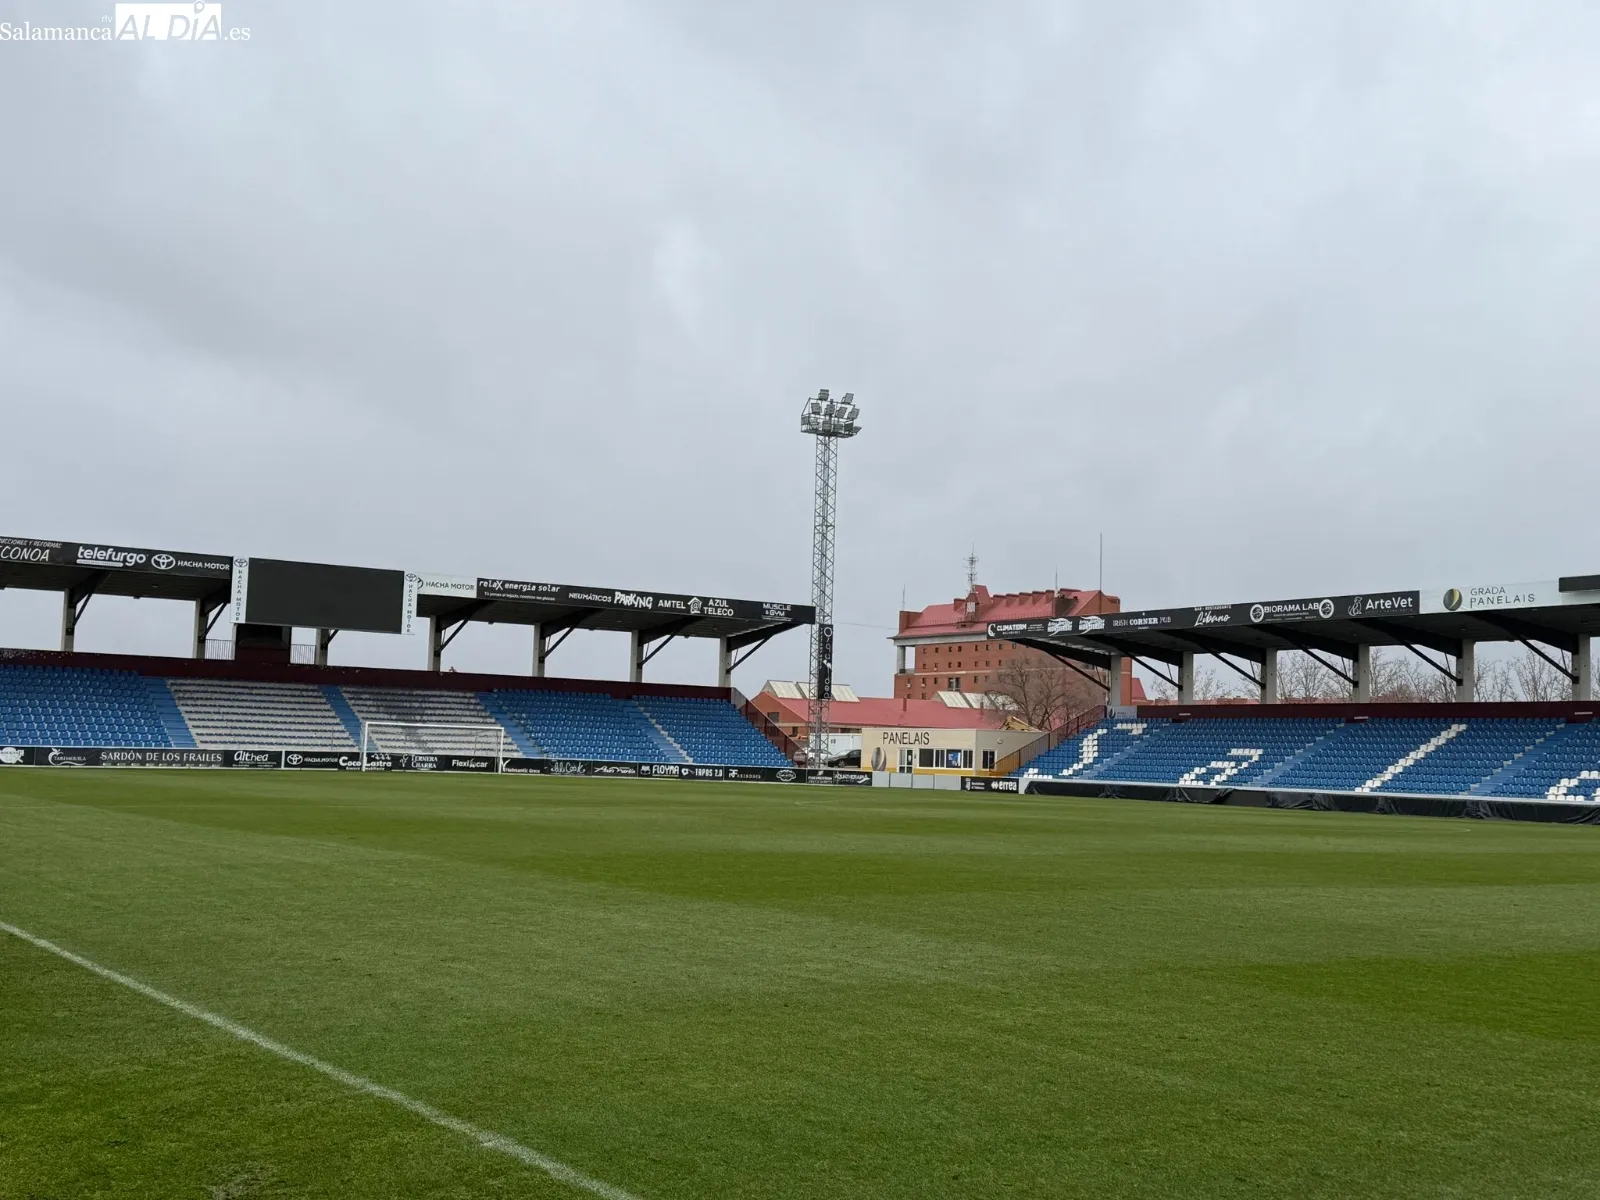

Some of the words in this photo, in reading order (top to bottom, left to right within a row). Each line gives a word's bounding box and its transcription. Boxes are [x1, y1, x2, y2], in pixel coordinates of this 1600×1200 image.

[0, 545, 50, 562] CONOA
[77, 546, 147, 567] telefurgo
[177, 560, 203, 568] HACHA
[204, 562, 230, 571] MOTOR
[425, 581, 449, 589] HACHA
[450, 583, 475, 591] MOTOR
[1470, 586, 1506, 596] GRADA
[657, 599, 687, 609] AMTEL
[708, 598, 729, 608] AZUL
[762, 602, 792, 611] MUSCLE
[1365, 596, 1413, 610] ArteVet
[1470, 594, 1535, 609] PANELAIS
[703, 606, 734, 617] TELECO
[1264, 603, 1301, 613] BIORAMA
[1302, 602, 1320, 611] LAB
[1129, 617, 1159, 626] CORNER
[882, 732, 930, 746] PANELAIS
[100, 750, 143, 761] SARDÓN
[146, 752, 160, 761] DE
[162, 752, 180, 761] LOS
[183, 752, 222, 762] FRAILES
